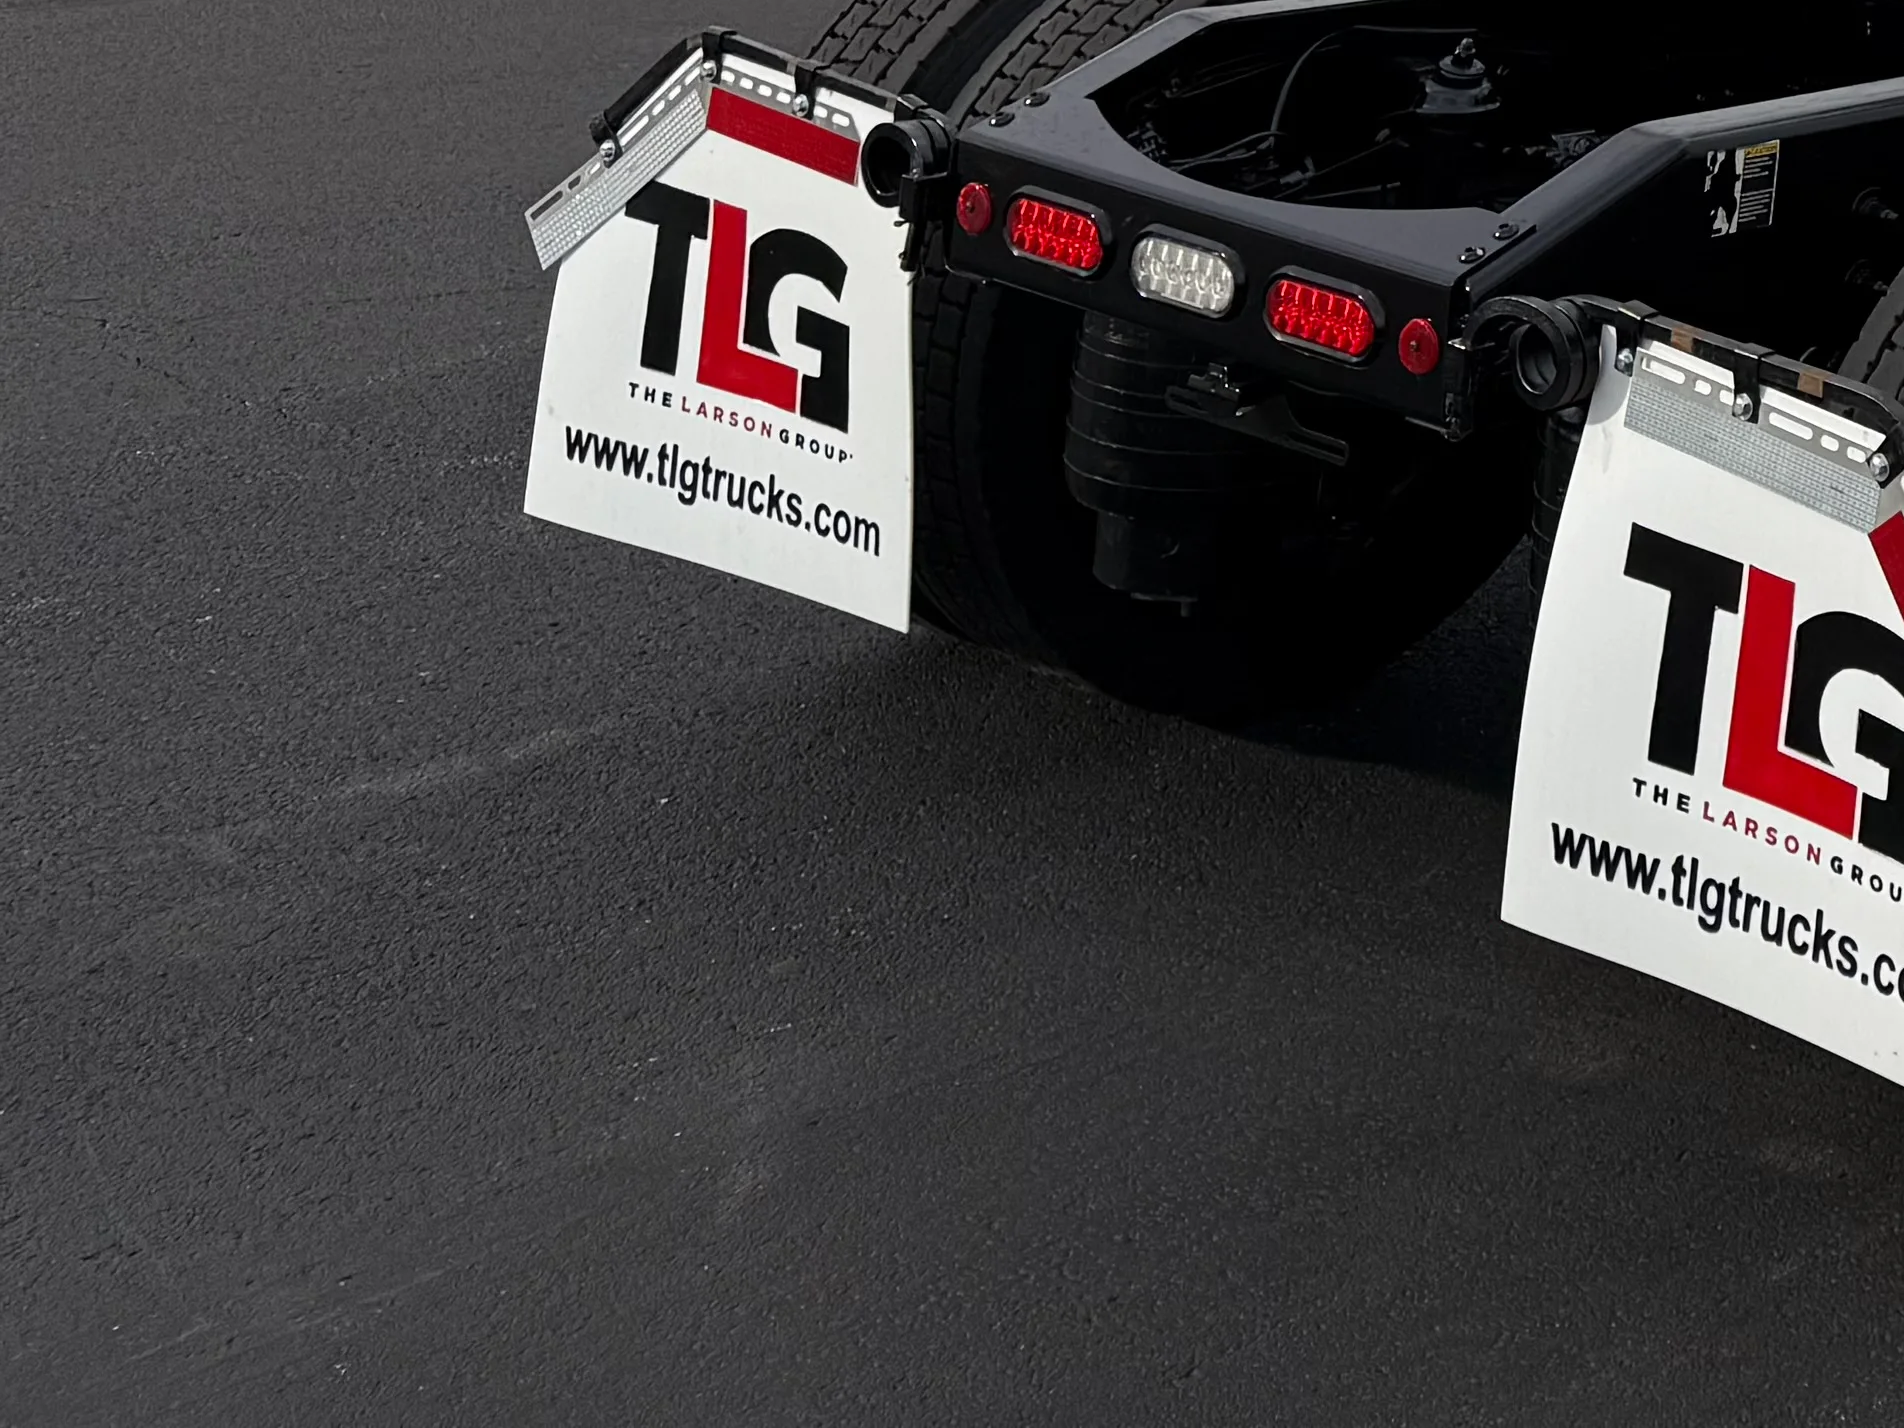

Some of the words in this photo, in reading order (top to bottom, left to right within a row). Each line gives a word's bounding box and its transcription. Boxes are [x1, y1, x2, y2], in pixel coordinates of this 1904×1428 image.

[624, 180, 850, 434] TLG
[628, 381, 673, 408] THE
[680, 396, 773, 439] LARSON
[778, 428, 851, 464] GROUP
[565, 424, 880, 557] www.tlgtrucks.com
[1632, 777, 1690, 813] THE
[1702, 800, 1821, 866] LARSON
